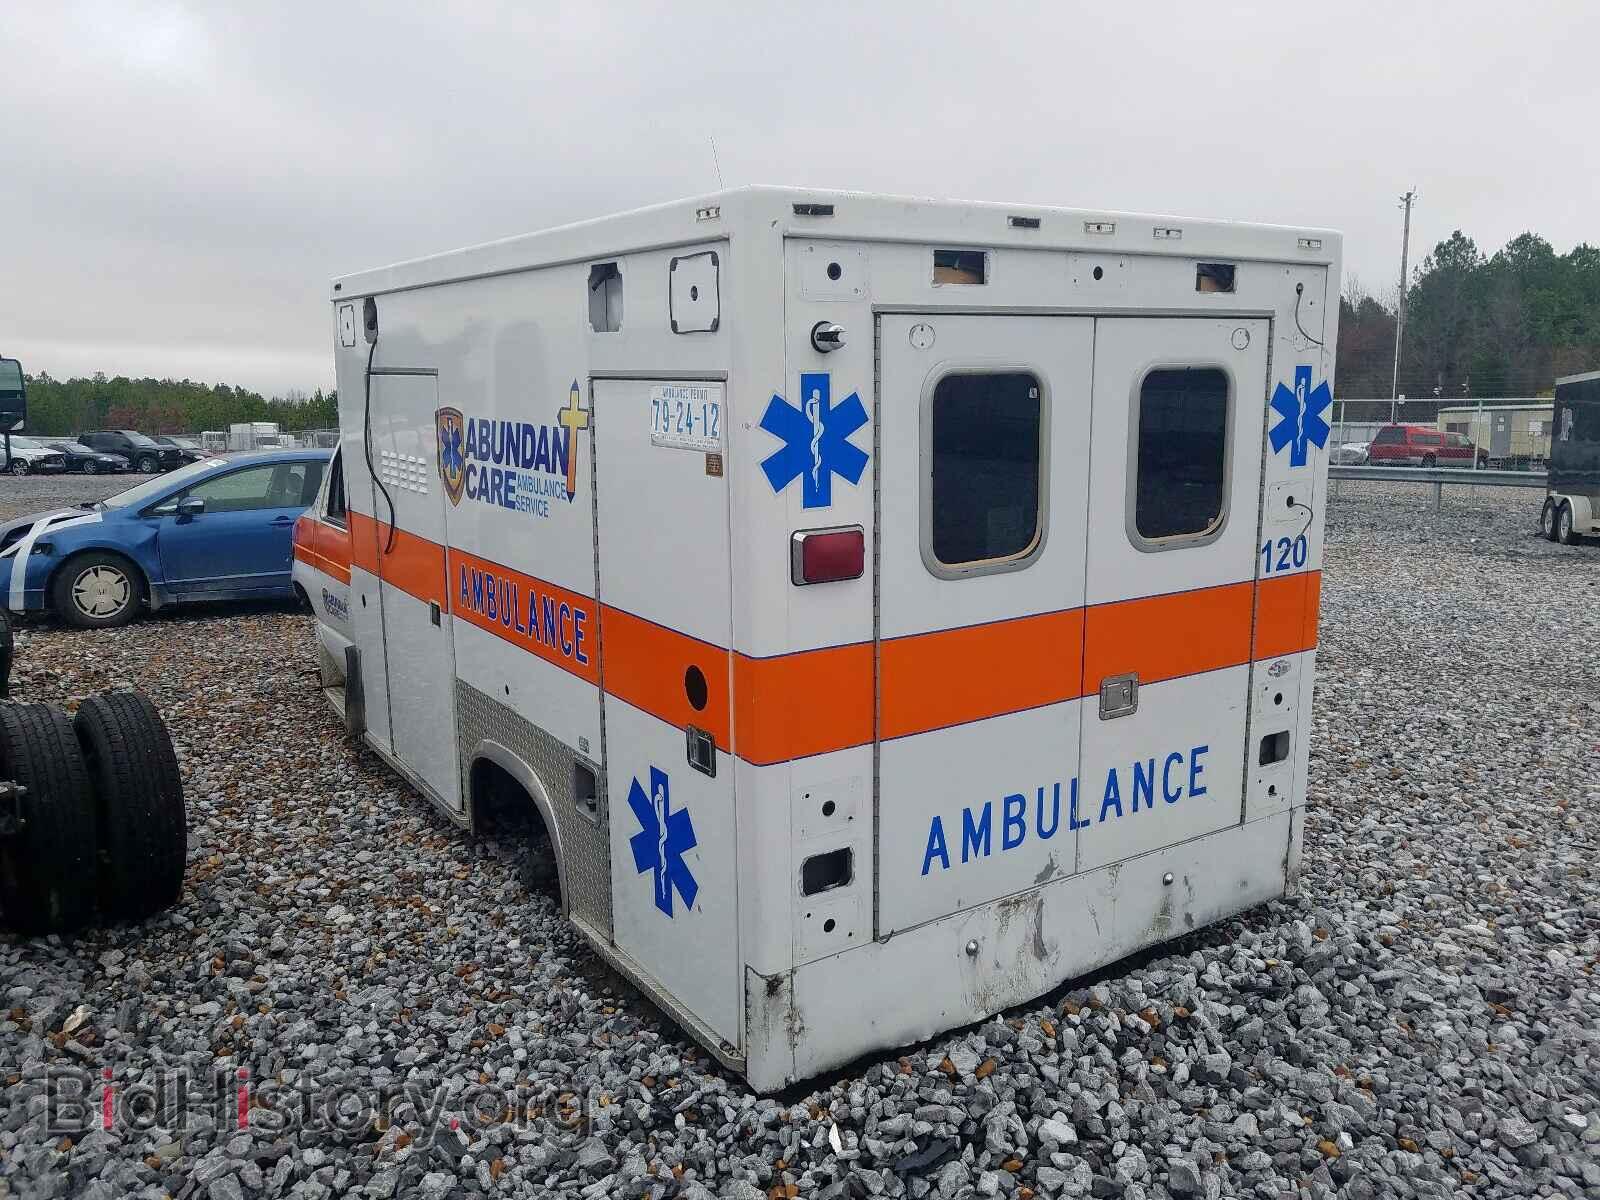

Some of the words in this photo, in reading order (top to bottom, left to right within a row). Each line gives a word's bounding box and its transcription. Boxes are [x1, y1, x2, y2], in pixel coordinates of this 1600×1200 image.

[652, 400, 719, 437] 79-24-12
[465, 463, 517, 510] CARE
[515, 494, 549, 518] SERVICE
[516, 474, 567, 500] AMBULANCE
[1261, 534, 1307, 573] 120
[460, 562, 589, 666] AMBULANCE
[921, 745, 1209, 876] AMBULANCE
